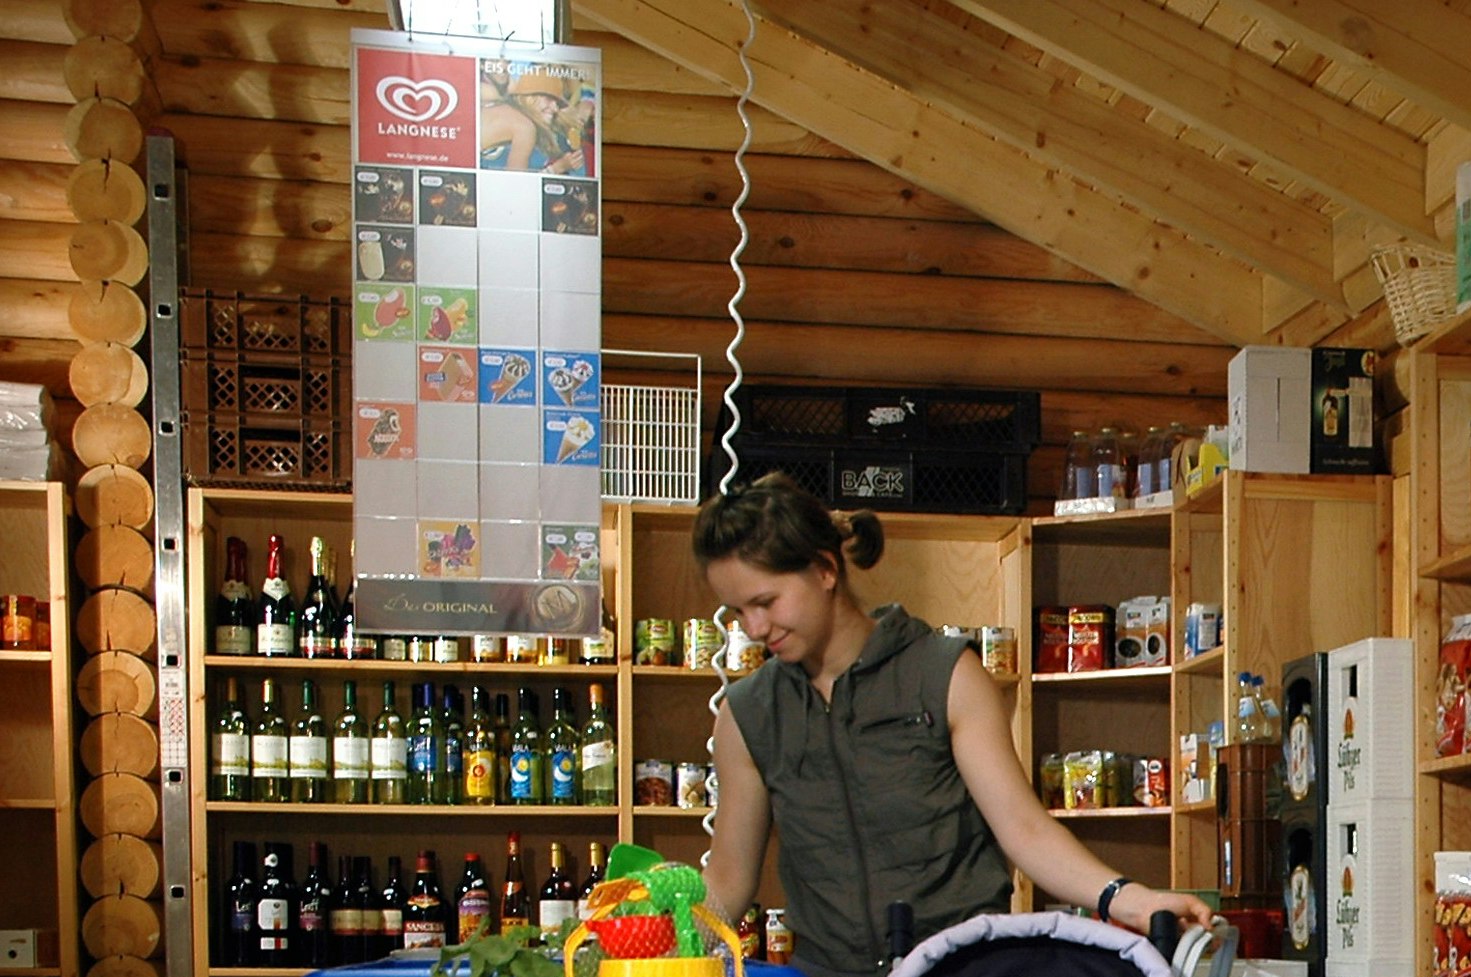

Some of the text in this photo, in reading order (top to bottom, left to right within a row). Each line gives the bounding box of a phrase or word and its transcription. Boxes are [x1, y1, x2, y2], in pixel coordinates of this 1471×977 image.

[484, 60, 504, 74] EIS
[507, 63, 543, 77] GEHT
[378, 122, 458, 140] LANGNESE
[386, 151, 449, 163] www.langnese.de
[841, 470, 904, 491] BACK
[422, 602, 497, 614] ORIGINAL
